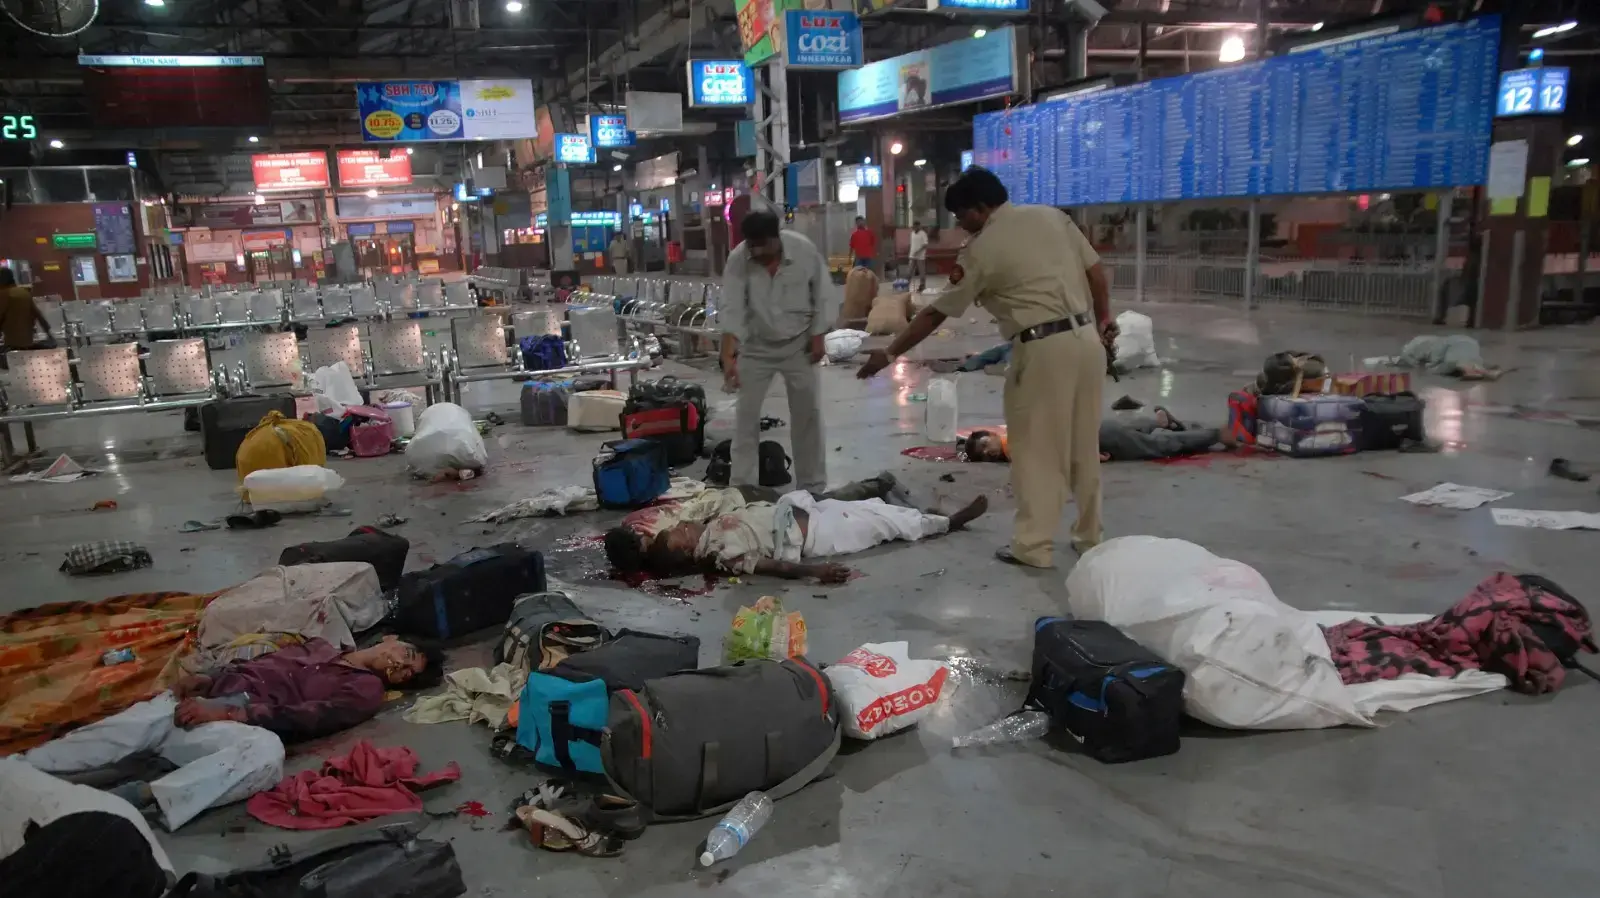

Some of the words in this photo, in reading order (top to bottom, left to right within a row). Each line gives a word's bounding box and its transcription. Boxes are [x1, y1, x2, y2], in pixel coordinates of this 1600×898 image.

[800, 15, 844, 28] LUX
[131, 56, 155, 65] TRAIN
[157, 57, 180, 66] NAME
[796, 55, 852, 63] INNERWEAR
[705, 65, 740, 74] LUX
[385, 84, 411, 97] SBH
[414, 83, 436, 95] 750
[1543, 85, 1564, 108] 12
[1504, 87, 1534, 112] 12
[3, 115, 36, 139] 25
